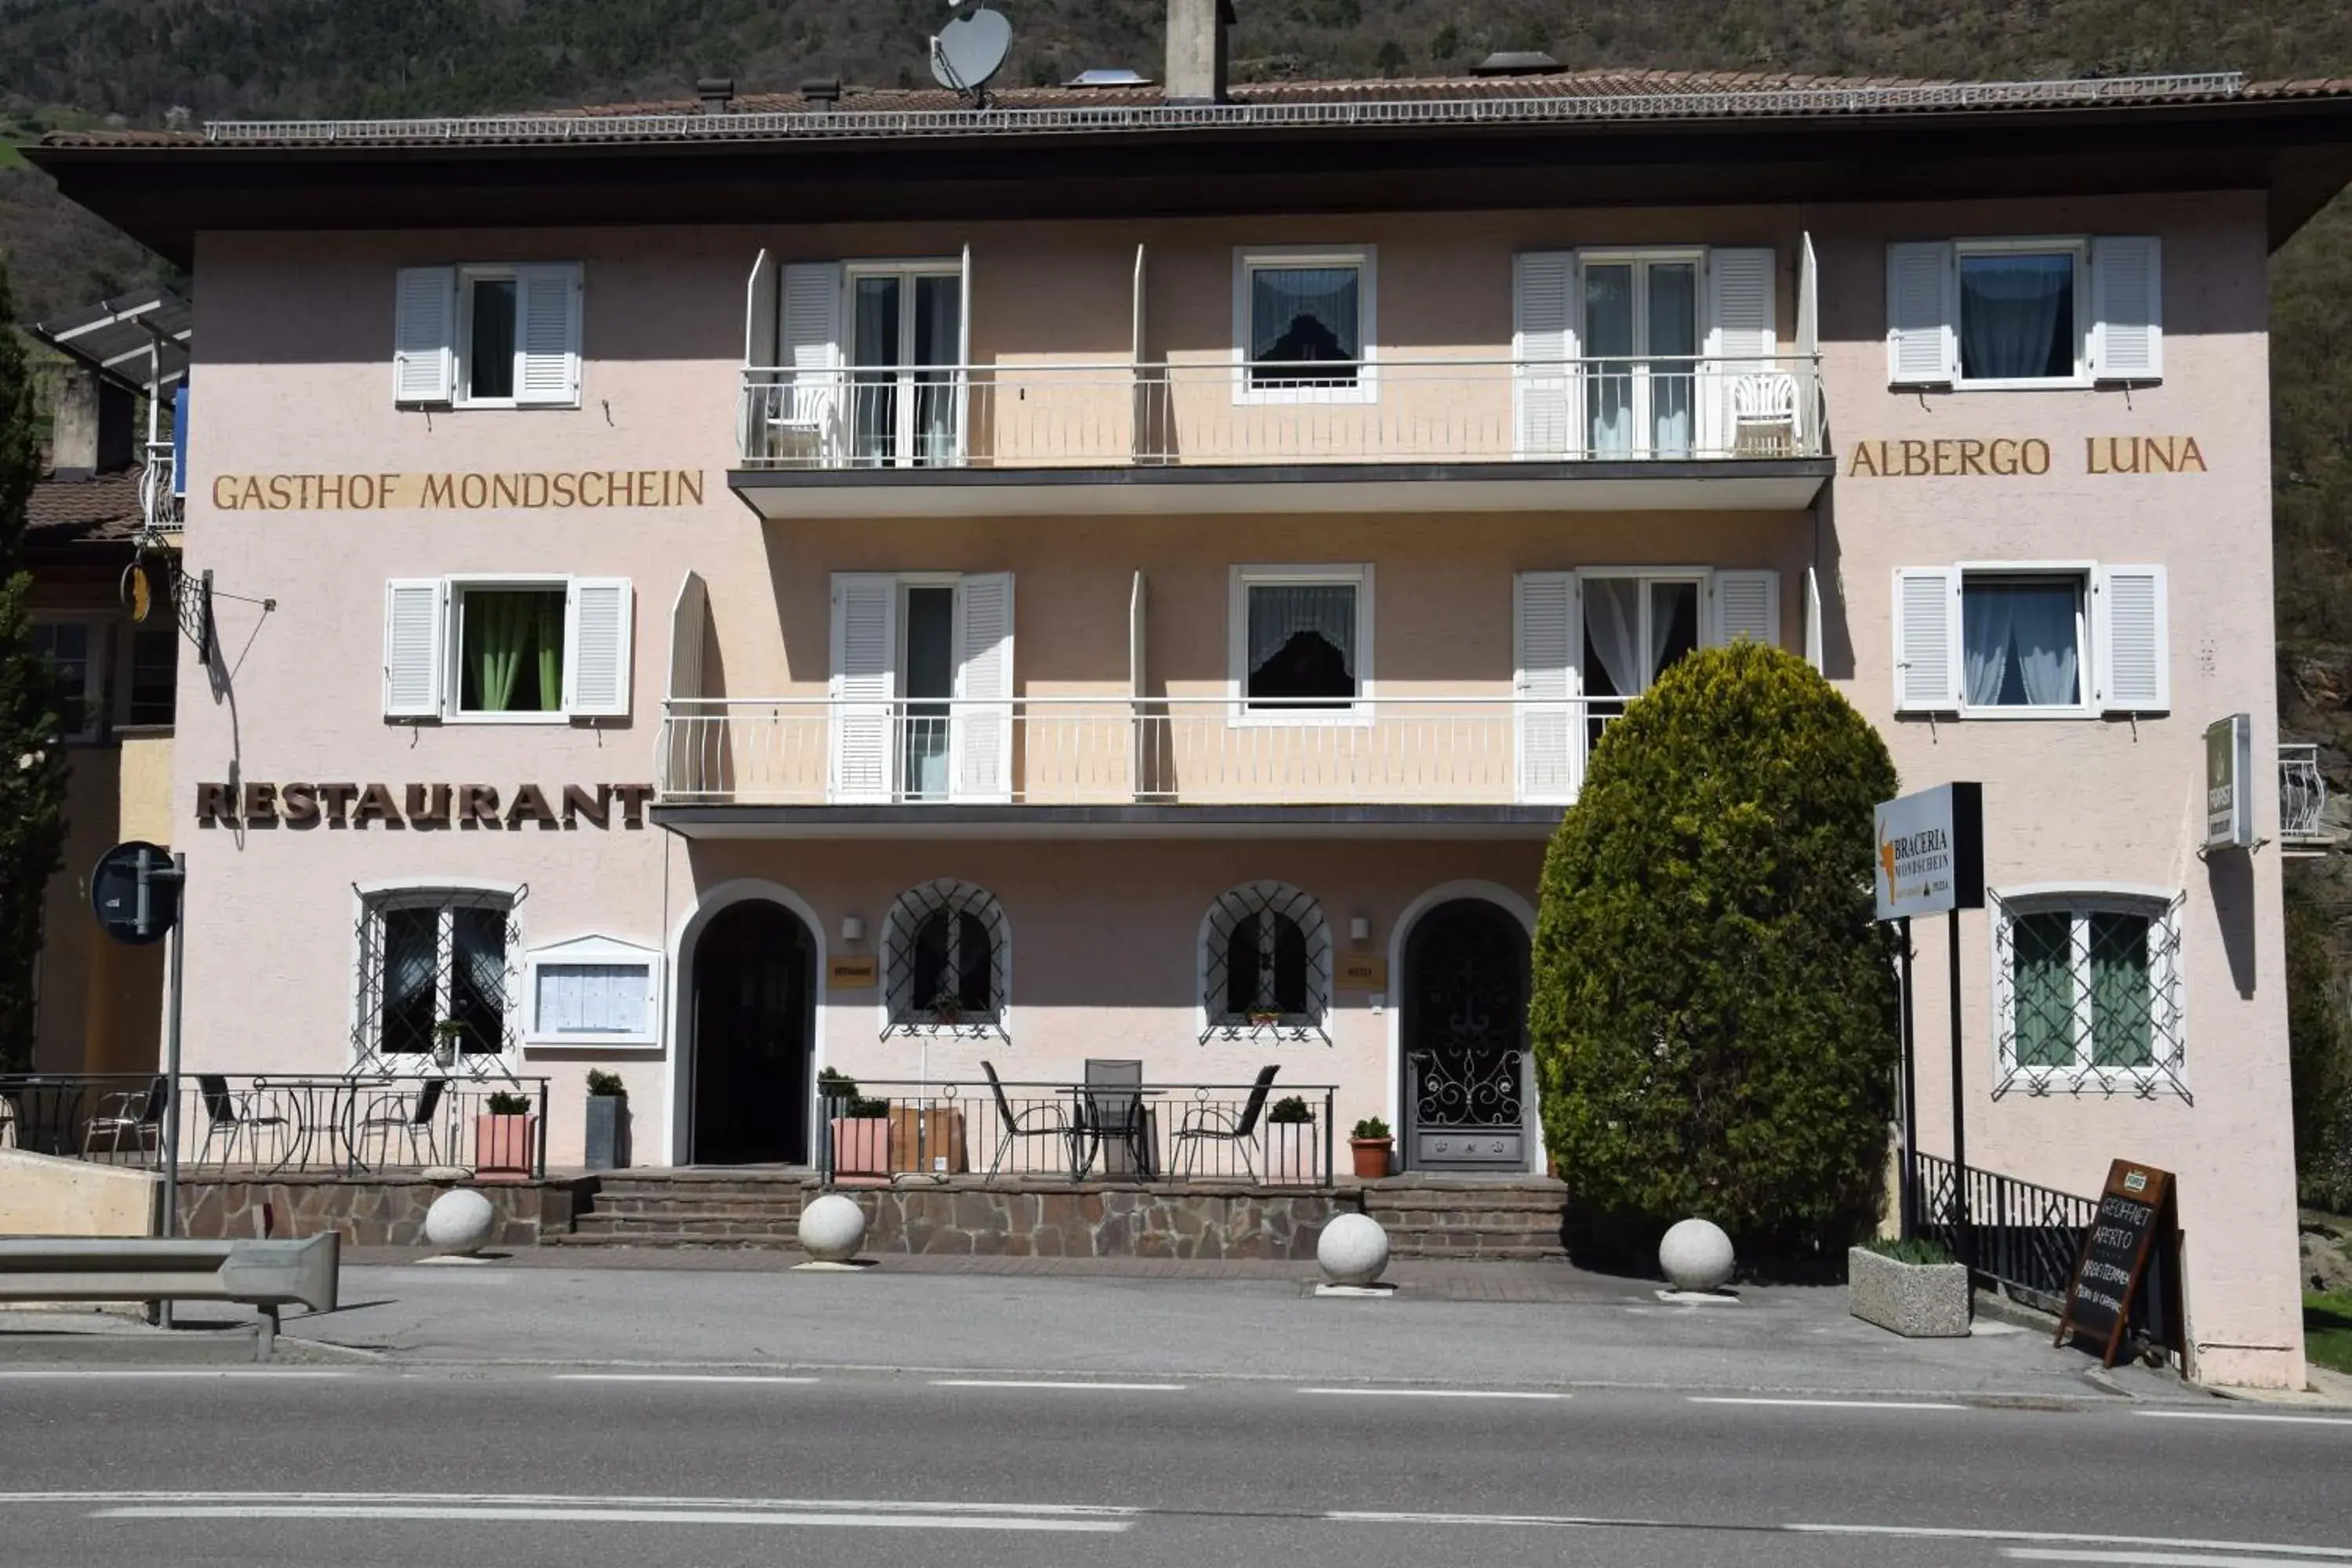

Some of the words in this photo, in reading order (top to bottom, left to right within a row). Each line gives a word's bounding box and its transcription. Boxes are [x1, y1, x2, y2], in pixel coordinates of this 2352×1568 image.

[1849, 438, 2050, 477] ALBERGO
[2085, 436, 2209, 474] LUNA
[212, 474, 401, 510] GASTHOF
[420, 470, 705, 509] MONDSCHEIN
[196, 782, 655, 828] RESTAURANT
[1894, 828, 1947, 860] BRACERIA
[2093, 1226, 2133, 1250] APERTO
